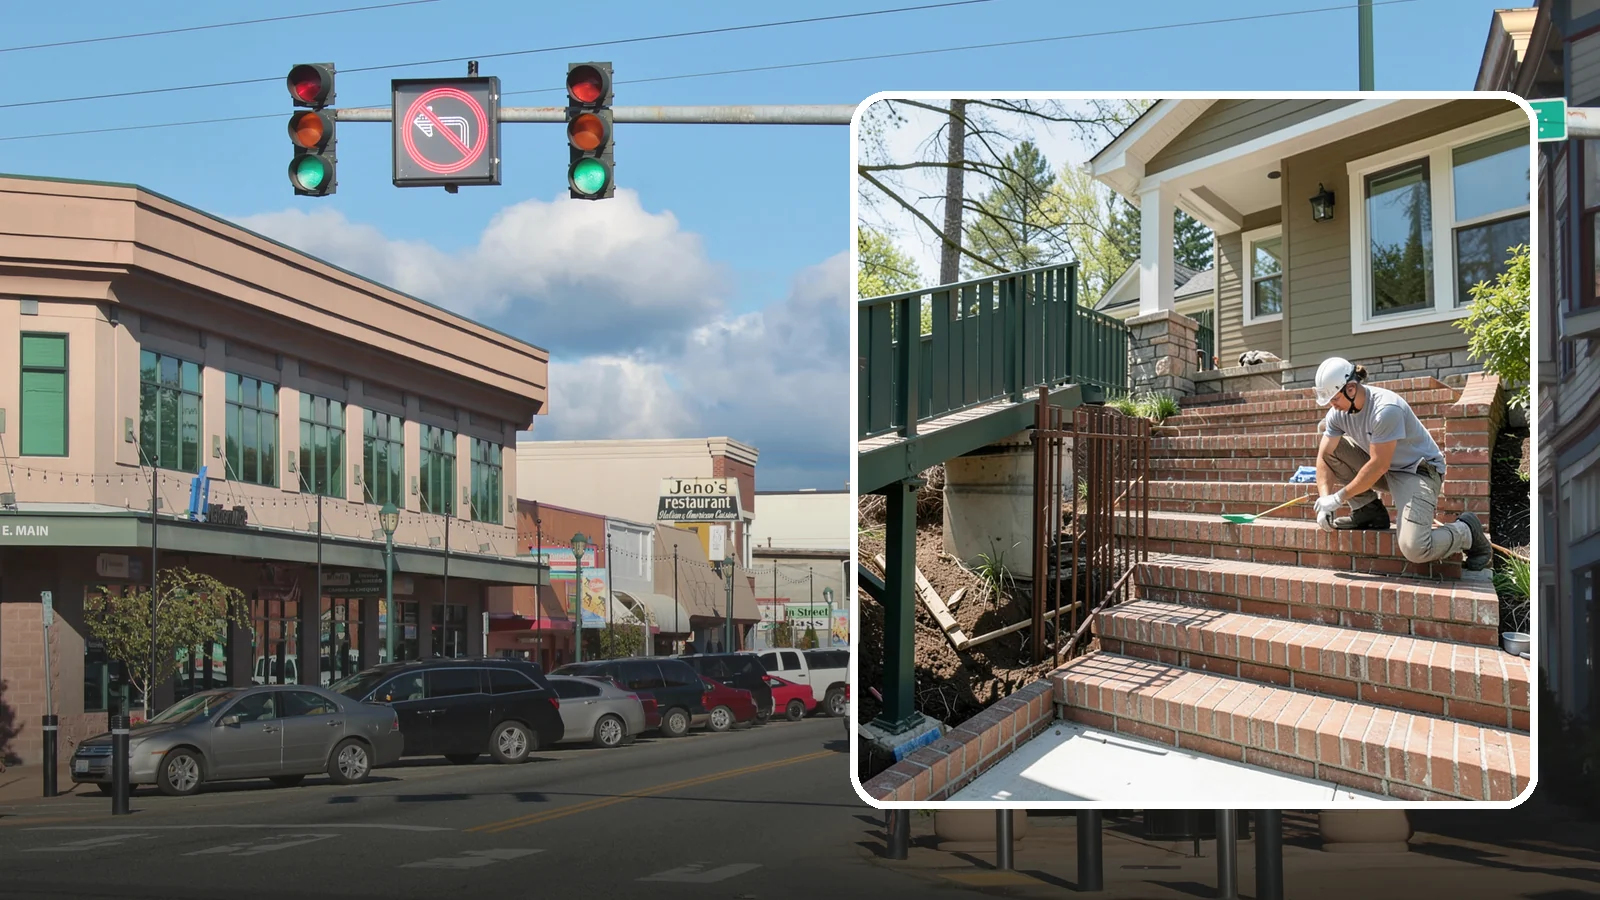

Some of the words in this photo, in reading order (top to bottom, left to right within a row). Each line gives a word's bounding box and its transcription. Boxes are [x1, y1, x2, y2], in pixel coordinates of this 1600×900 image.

[669, 480, 727, 494] Jeno's
[665, 496, 731, 509] restaurant
[658, 509, 681, 520] Italian
[686, 509, 714, 519] American
[715, 509, 737, 519] Cuisine
[2, 525, 13, 536] E.
[15, 525, 49, 536] MAIN
[797, 607, 828, 617] Street
[790, 619, 824, 627] lass
